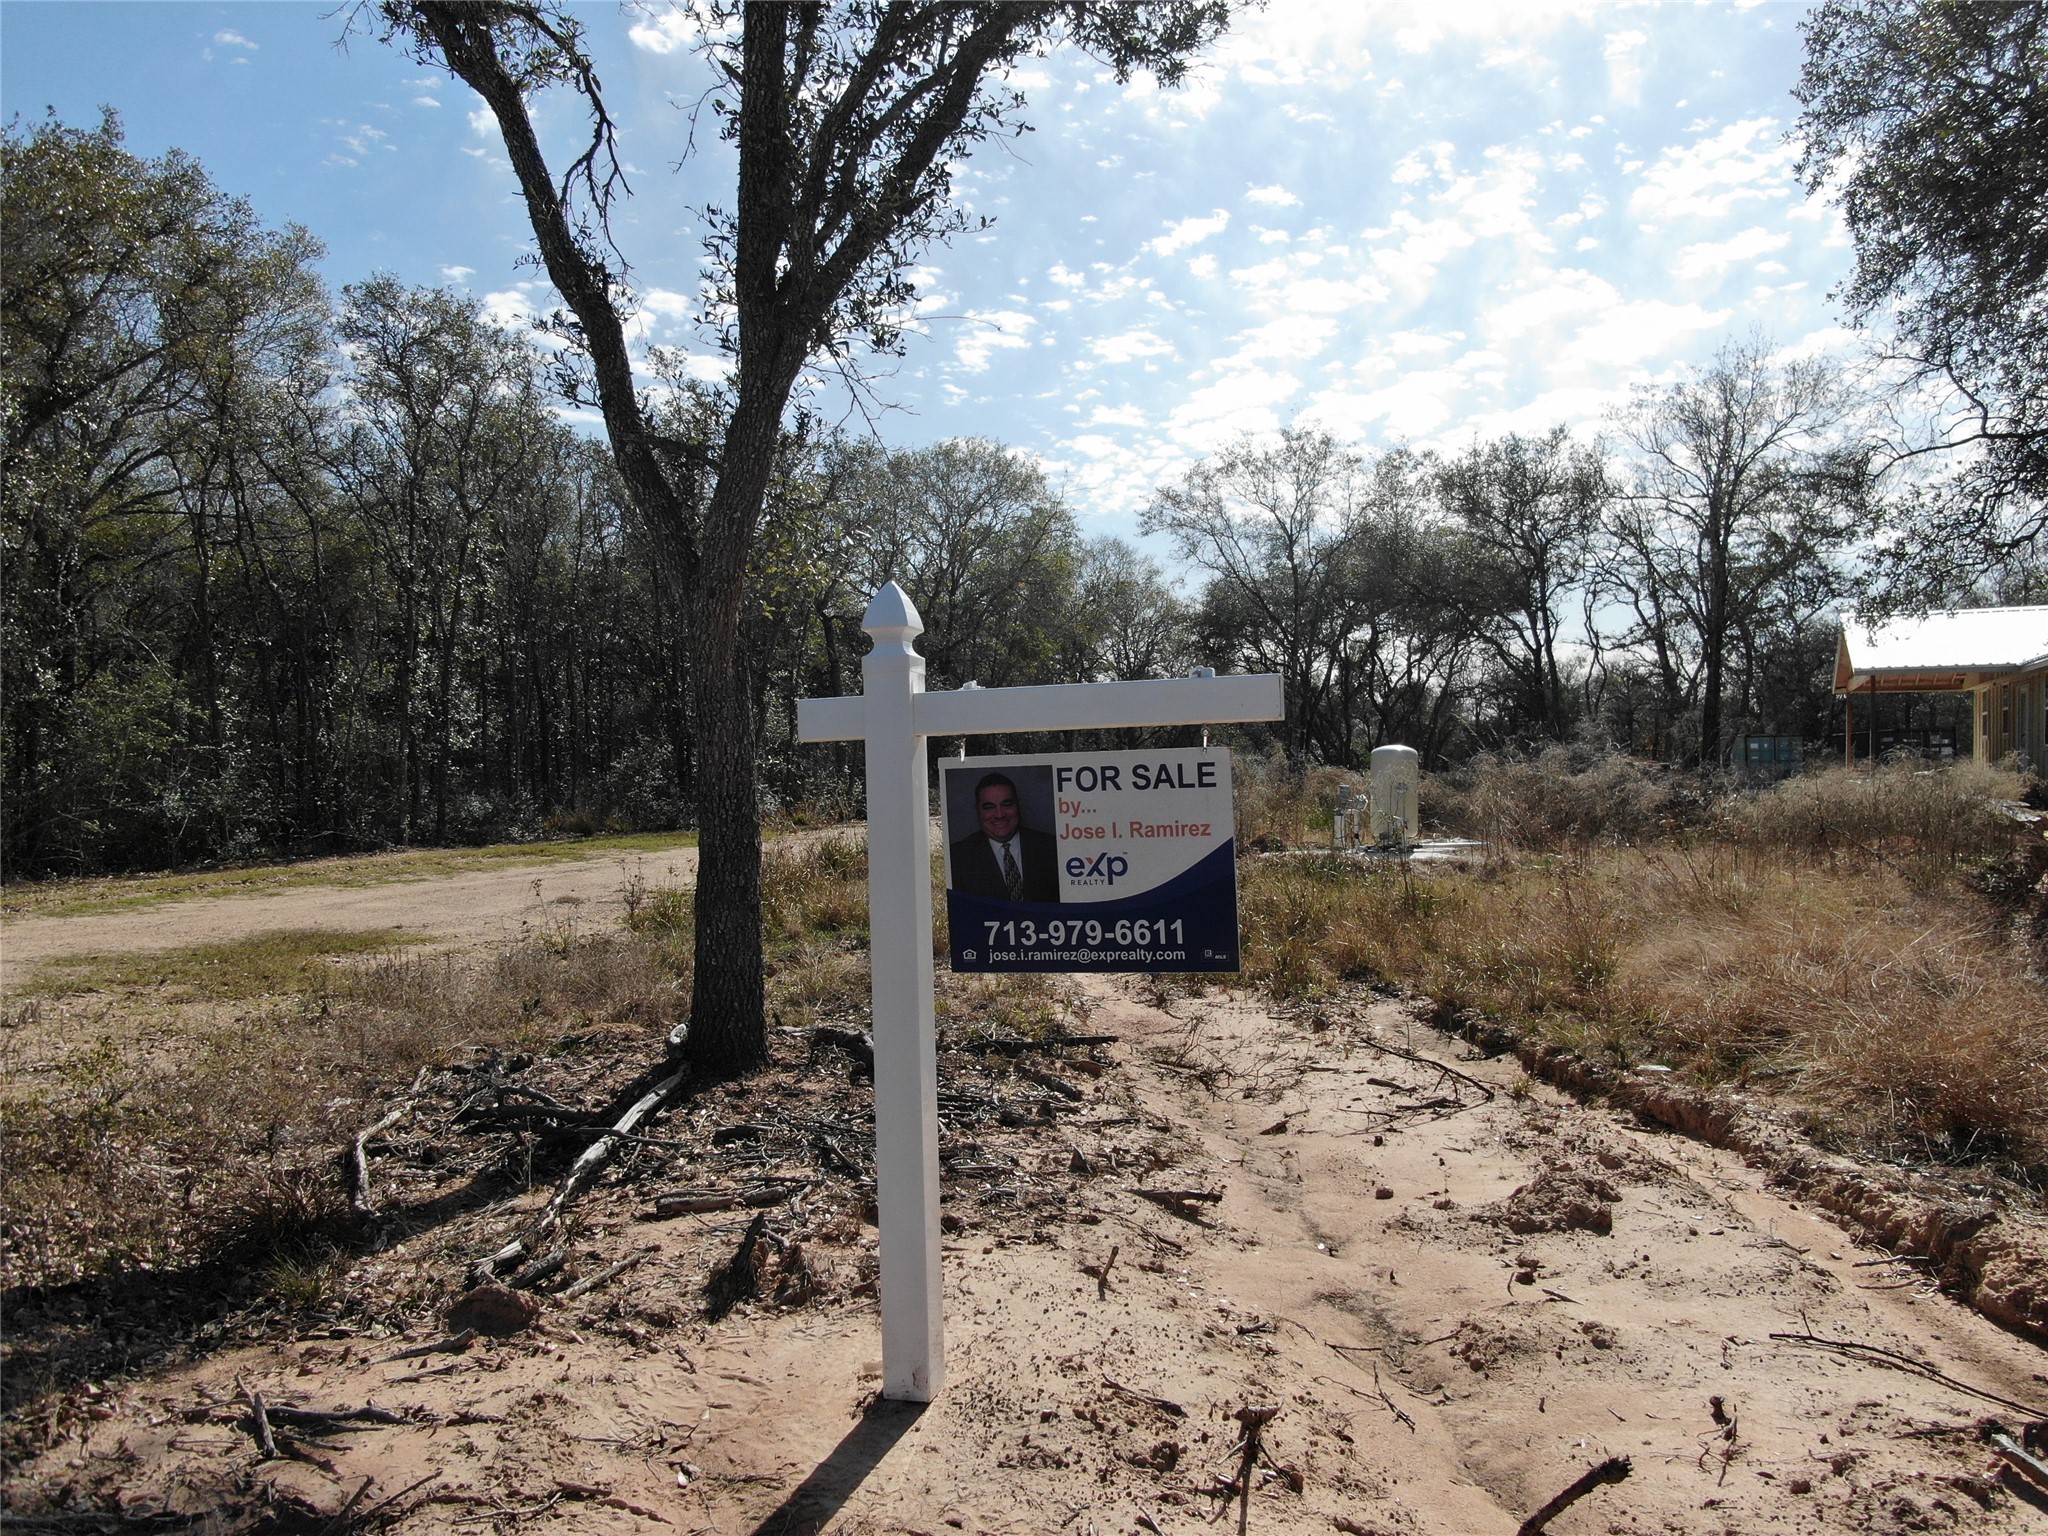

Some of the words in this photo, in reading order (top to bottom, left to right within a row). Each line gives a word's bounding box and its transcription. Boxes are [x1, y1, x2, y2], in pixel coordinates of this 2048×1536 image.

[1056, 766, 1122, 793] FOR
[1132, 762, 1217, 790] SALE
[1058, 798, 1097, 818] by...
[1059, 823, 1105, 840] Jose
[1129, 820, 1211, 839] Ramirez
[984, 919, 1183, 946] 713-979-6611
[989, 948, 1186, 964] jose.i.ramirez@exprealty.com
